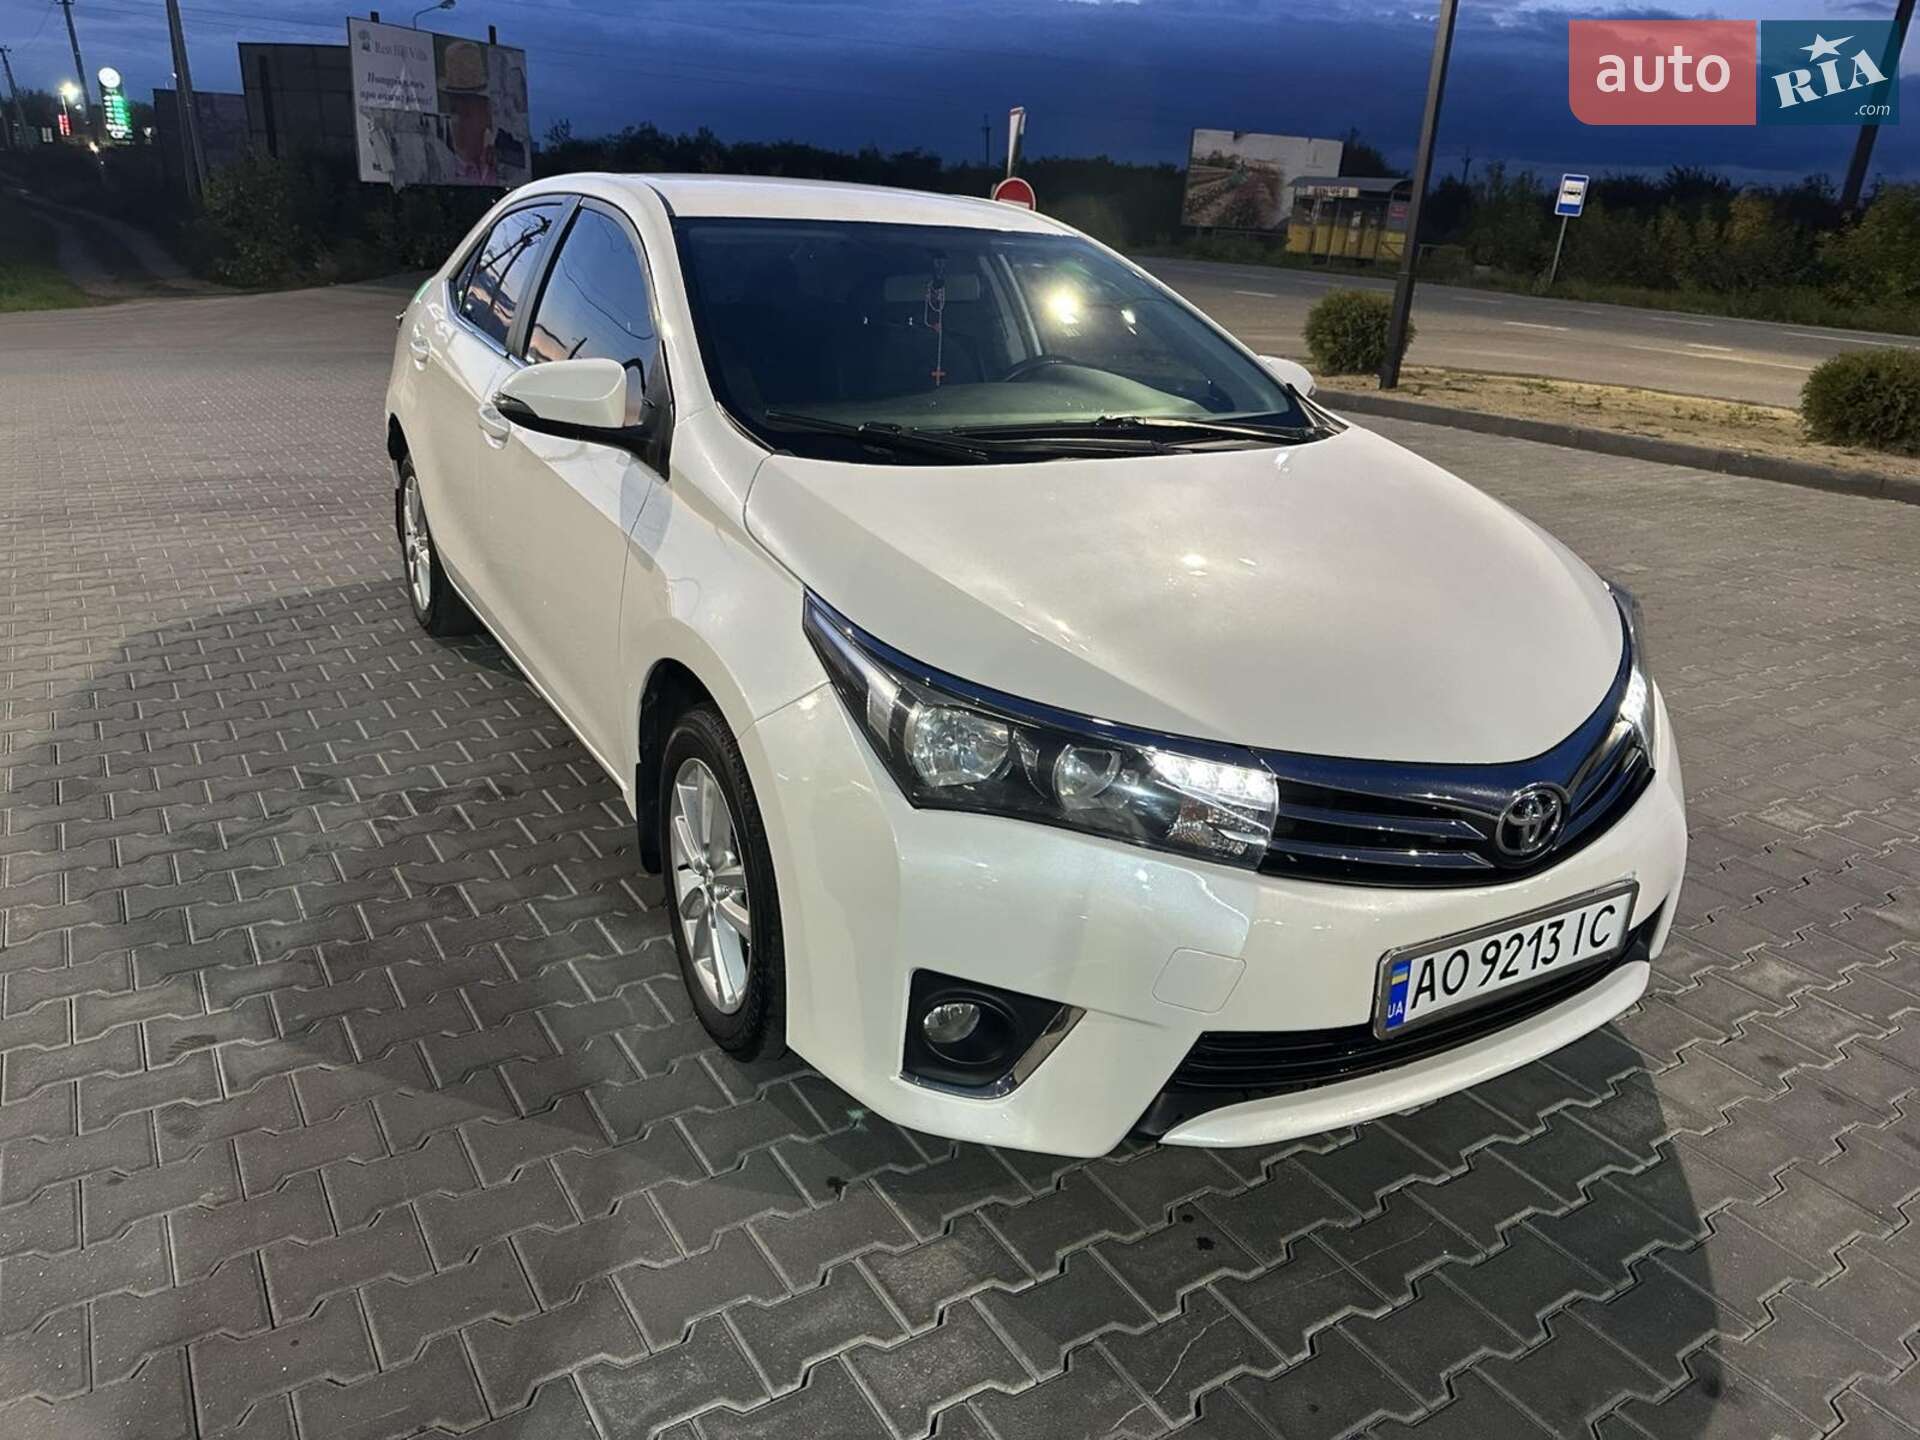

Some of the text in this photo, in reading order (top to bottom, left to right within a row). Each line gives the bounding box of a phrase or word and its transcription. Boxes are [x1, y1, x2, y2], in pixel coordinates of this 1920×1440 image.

[1410, 904, 1616, 1009] AO 9213 IC
[1387, 1001, 1404, 1019] UA
